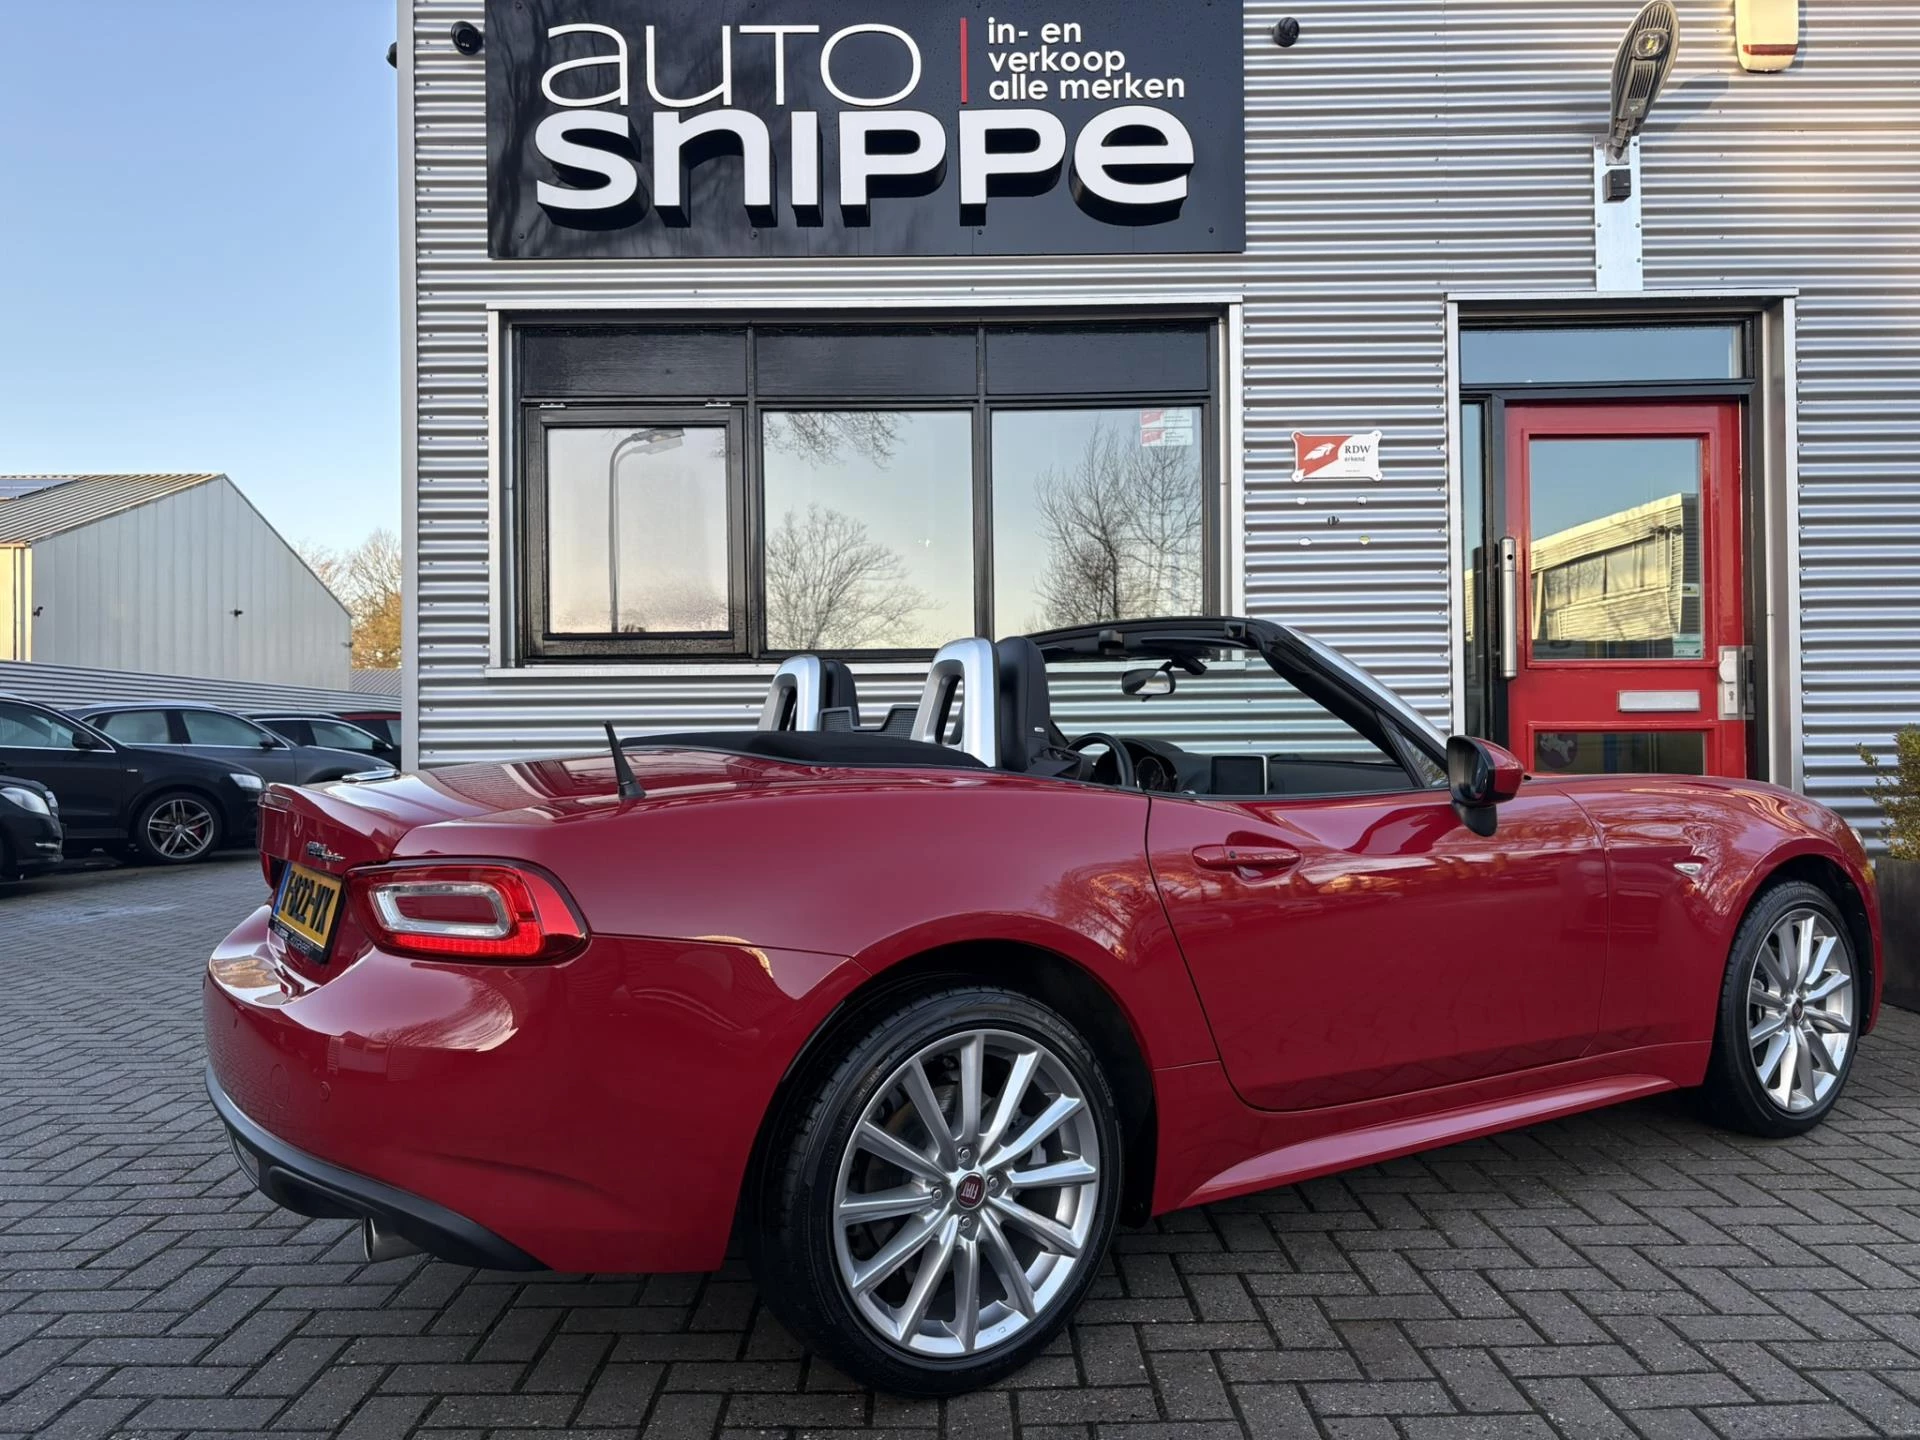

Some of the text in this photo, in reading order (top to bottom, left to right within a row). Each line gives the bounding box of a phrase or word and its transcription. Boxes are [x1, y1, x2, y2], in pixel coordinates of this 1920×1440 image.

[988, 18, 1082, 44] in- en
[988, 45, 1126, 77] verkoop
[988, 72, 1185, 100] alle merken
[1344, 445, 1371, 454] RDW
